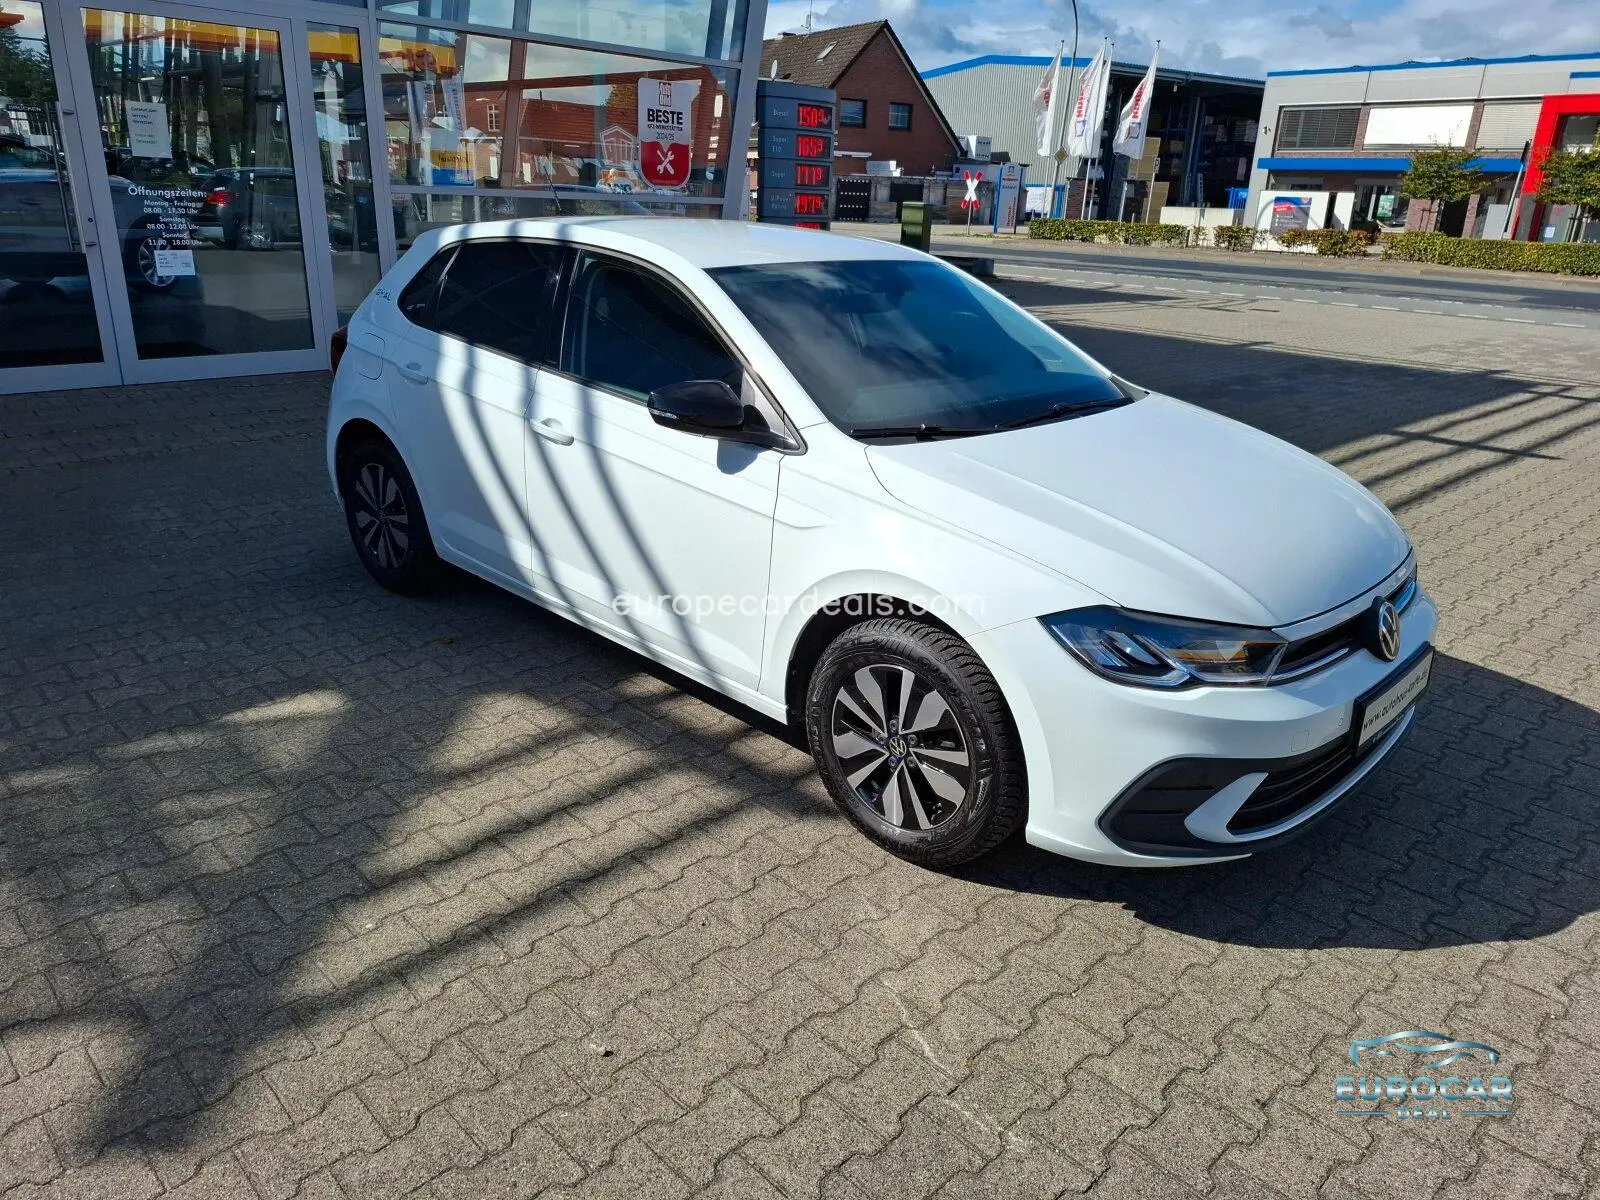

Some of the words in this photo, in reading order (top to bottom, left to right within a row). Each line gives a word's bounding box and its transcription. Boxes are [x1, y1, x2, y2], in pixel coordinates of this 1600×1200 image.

[647, 108, 683, 125] BESTE
[773, 108, 789, 117] Diesel
[656, 132, 675, 140] 2024/25
[128, 184, 207, 198] Öffnungszeiten:
